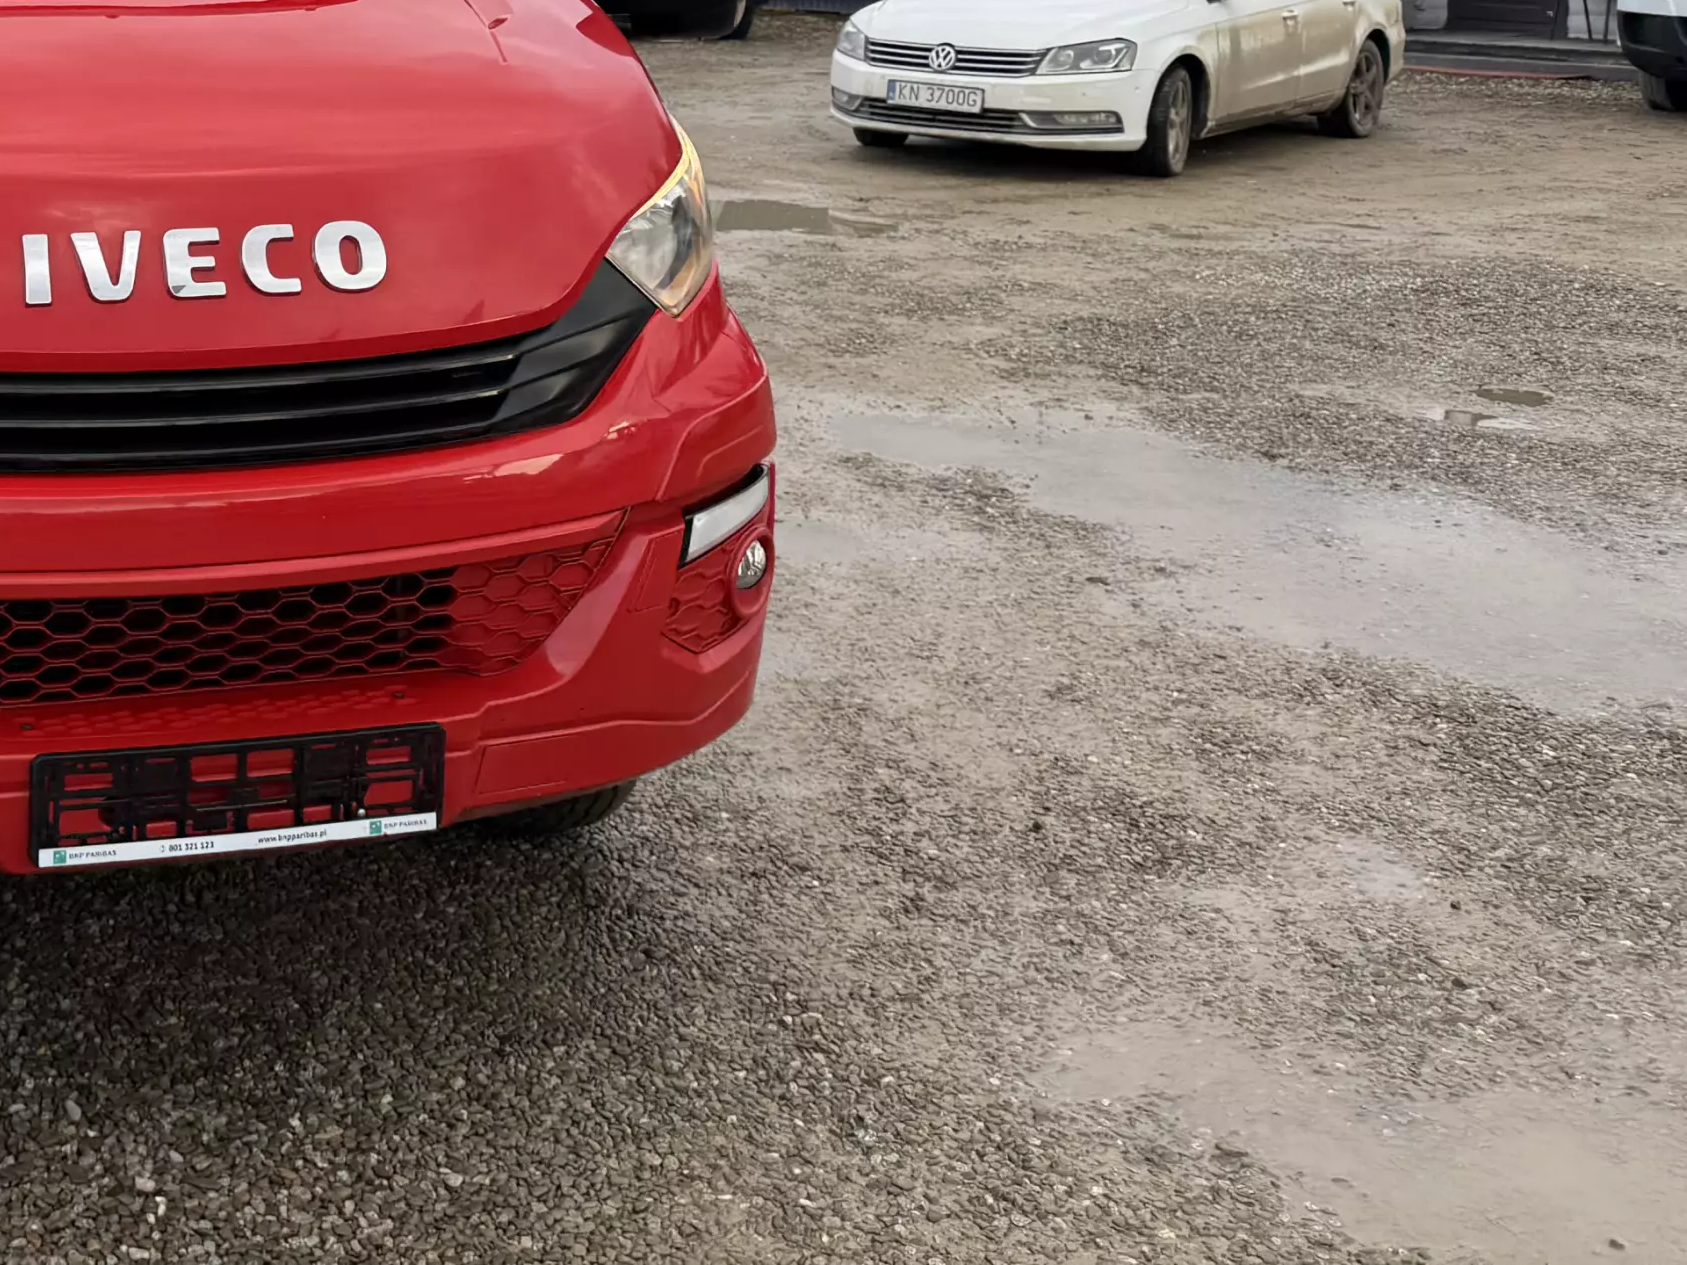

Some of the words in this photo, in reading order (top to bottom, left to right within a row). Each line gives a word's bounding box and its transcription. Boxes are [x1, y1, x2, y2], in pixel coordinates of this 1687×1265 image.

[898, 83, 919, 102] KN
[926, 86, 978, 107] 3700G
[22, 220, 388, 306] IVECO
